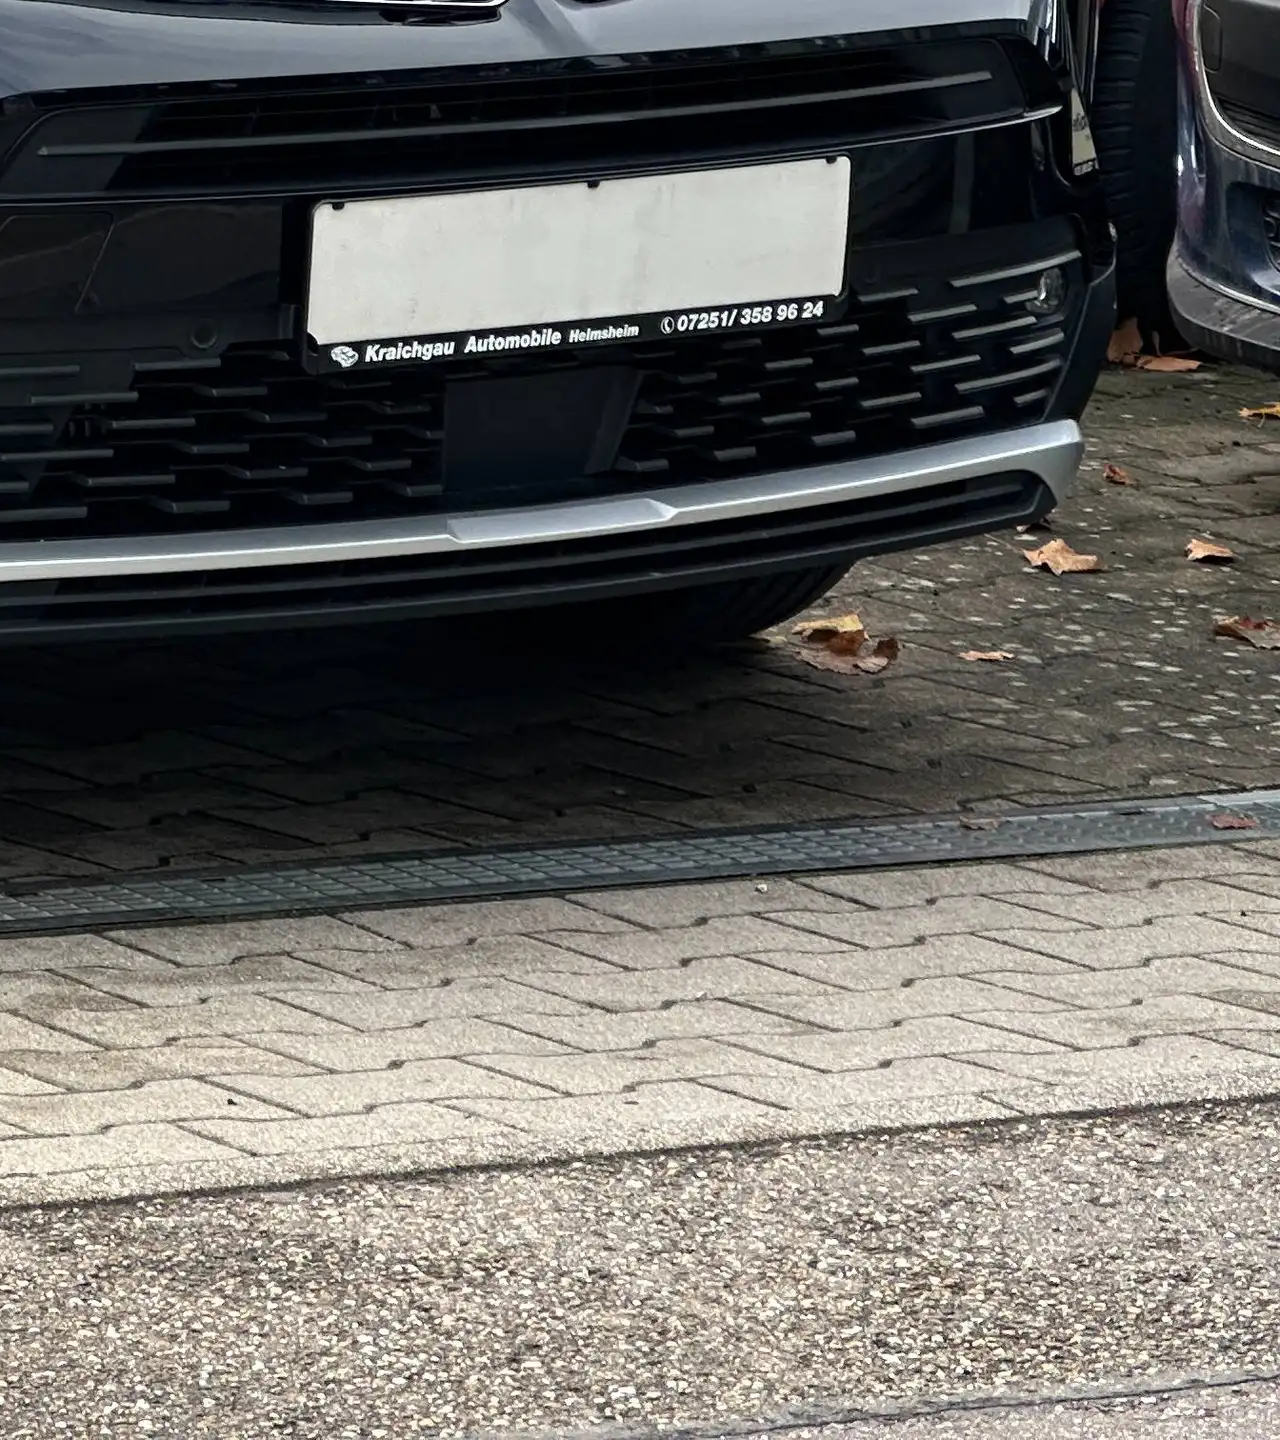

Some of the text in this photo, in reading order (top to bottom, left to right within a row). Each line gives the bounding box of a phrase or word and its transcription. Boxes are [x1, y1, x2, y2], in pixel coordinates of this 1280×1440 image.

[364, 340, 455, 362] Kraichgau
[464, 329, 562, 354] Automobile
[676, 309, 738, 332] 07251/
[740, 305, 773, 326] 358
[776, 303, 798, 321] 96
[801, 300, 824, 318] 24
